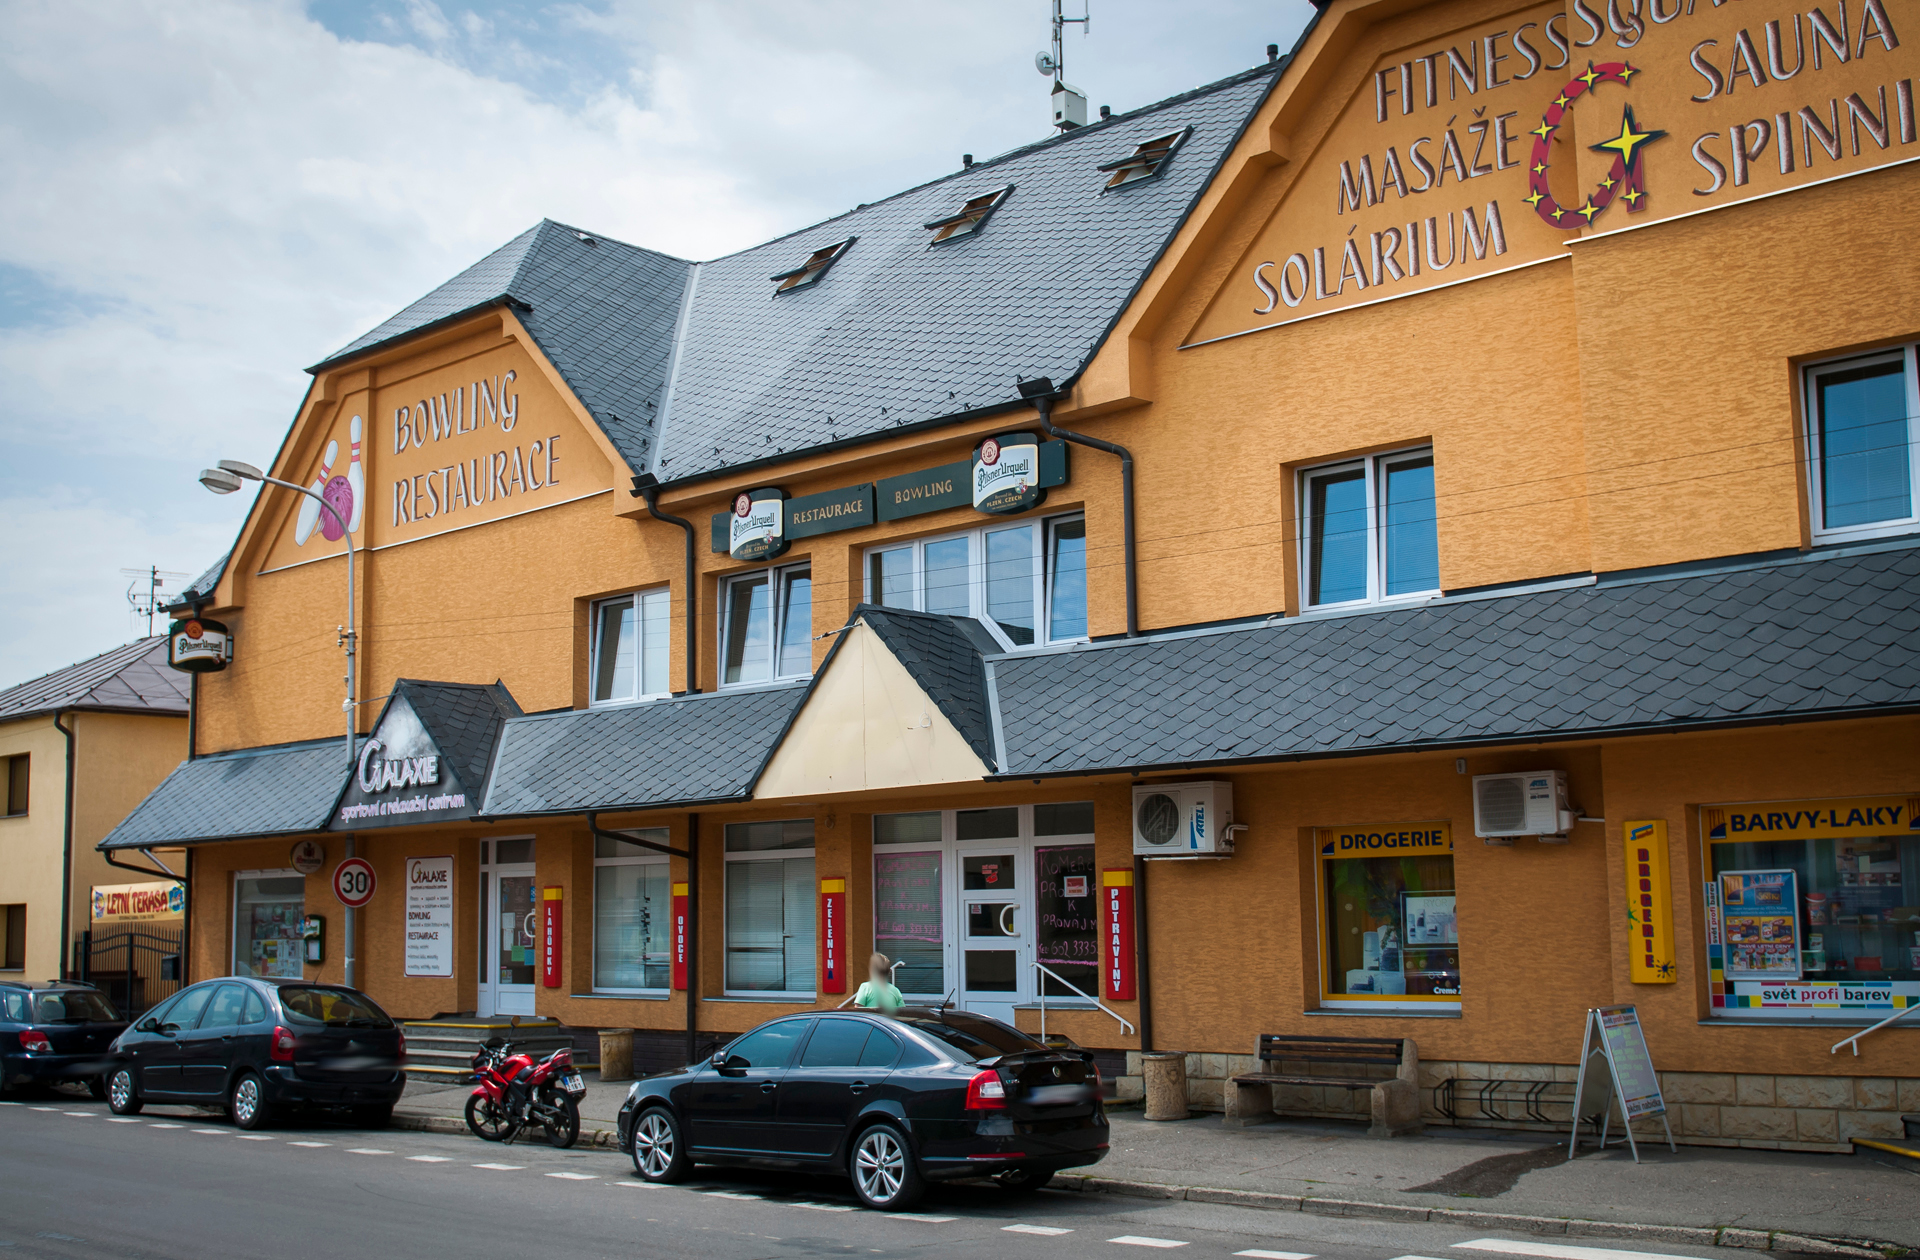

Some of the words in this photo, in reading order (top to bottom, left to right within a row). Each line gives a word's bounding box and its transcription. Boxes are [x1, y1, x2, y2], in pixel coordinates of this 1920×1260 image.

[1689, 0, 1900, 103] SAUNA
[1374, 13, 1570, 123] FITNESS
[1338, 106, 1520, 215] MASÁŽE
[1253, 200, 1507, 315] SOLÁRIUM
[393, 369, 519, 455] BOWLING
[392, 435, 561, 527] RESTAURACE
[1000, 458, 1029, 477] Urquell
[793, 500, 863, 525] RESTAURACE
[895, 479, 953, 504] BOWLING
[751, 512, 775, 529] Urquell
[357, 738, 440, 794] GALAXIE
[380, 804, 387, 816] a
[1730, 805, 1904, 833] BARVY-LAKY
[1340, 830, 1443, 850] DROGERIE
[342, 871, 367, 894] 30
[107, 886, 132, 914] LETNÍ
[132, 890, 168, 914] TERASA
[1067, 899, 1076, 912] K
[1637, 848, 1655, 968] DROGERIE
[408, 911, 431, 920] BOWLING
[408, 931, 439, 940] RESTAURACE
[1051, 940, 1070, 958] 602
[1111, 889, 1121, 992] POTRAVINY
[1763, 986, 1796, 1001] svět
[1801, 987, 1838, 1003] profi
[1844, 988, 1891, 1001] barev
